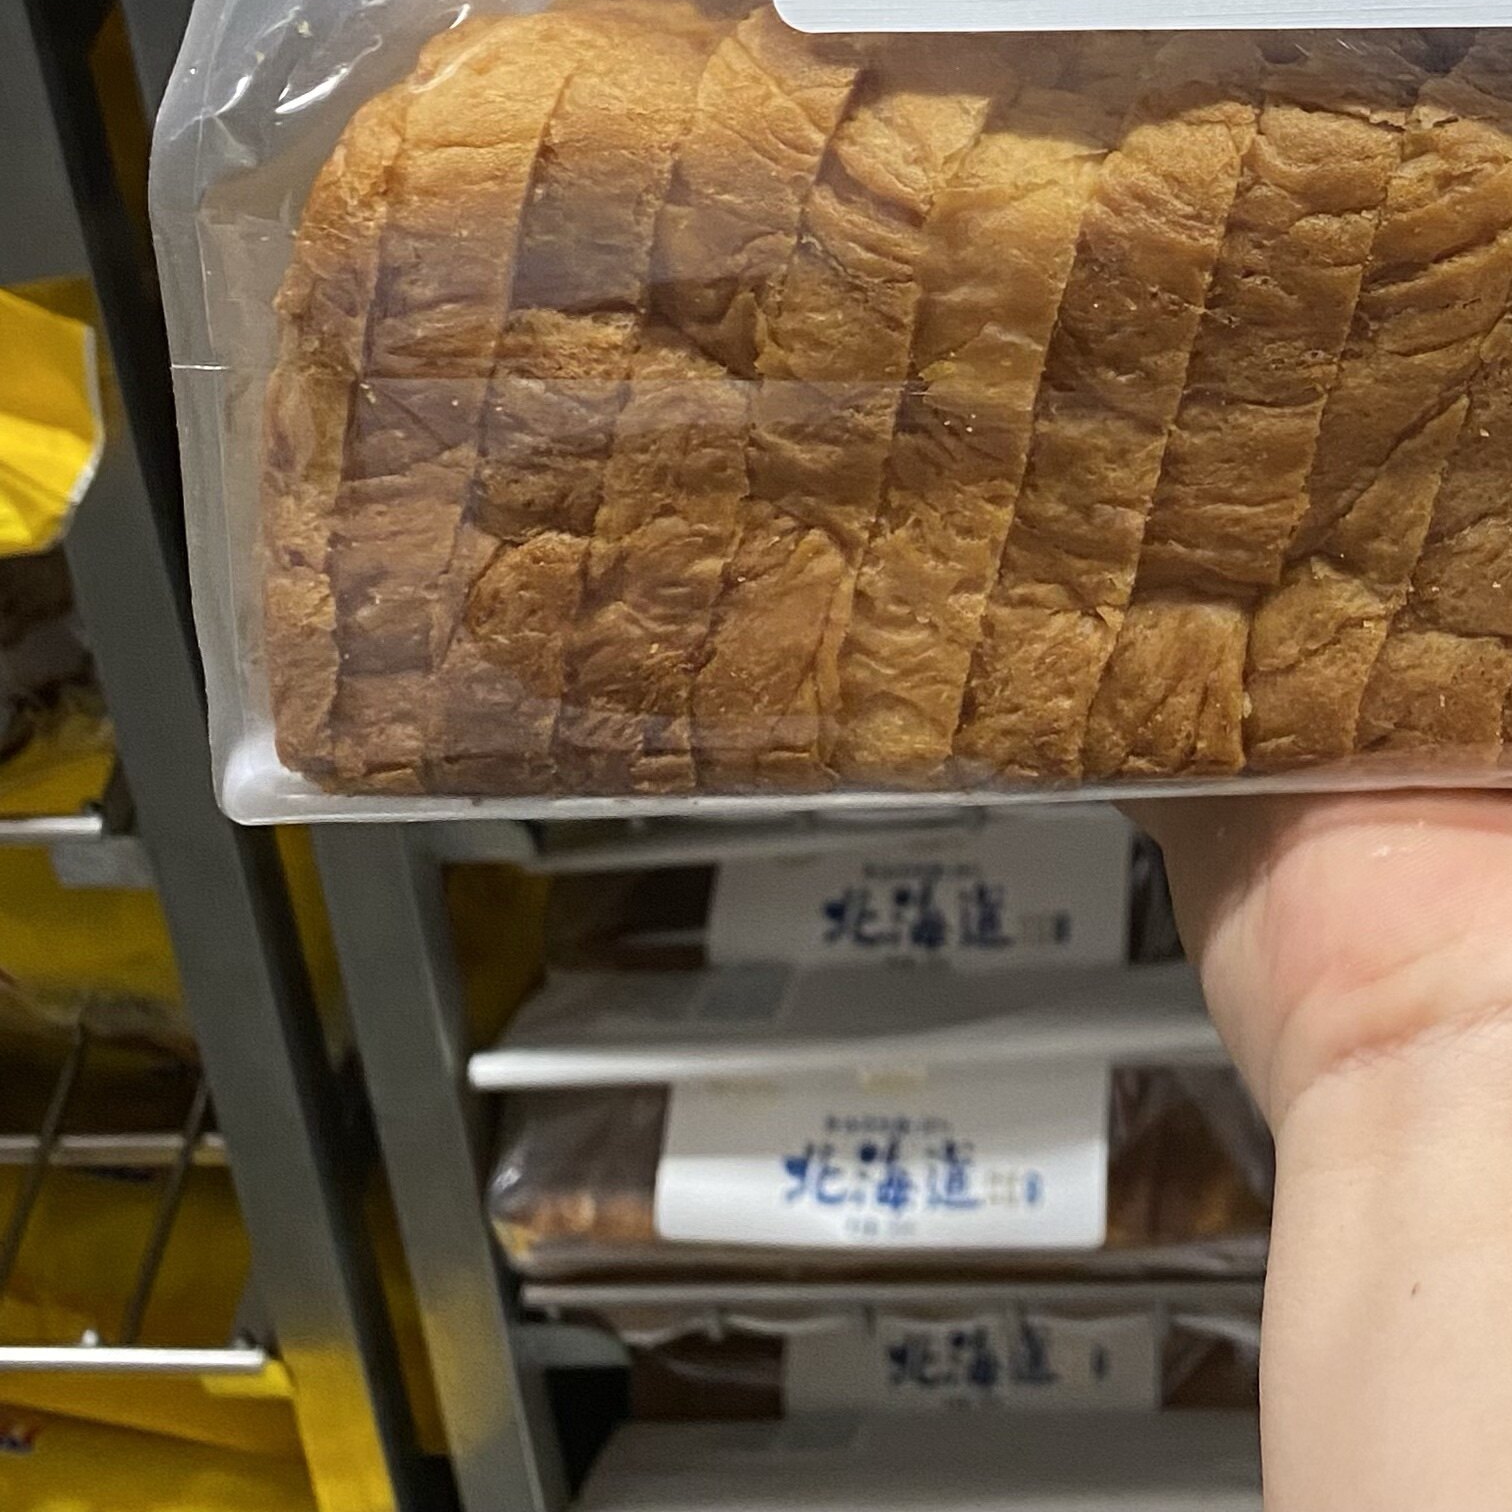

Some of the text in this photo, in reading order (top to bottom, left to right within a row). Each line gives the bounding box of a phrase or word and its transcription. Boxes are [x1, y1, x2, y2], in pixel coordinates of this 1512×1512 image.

[822, 881, 1018, 948] 北海道
[782, 1139, 984, 1211] 北海道
